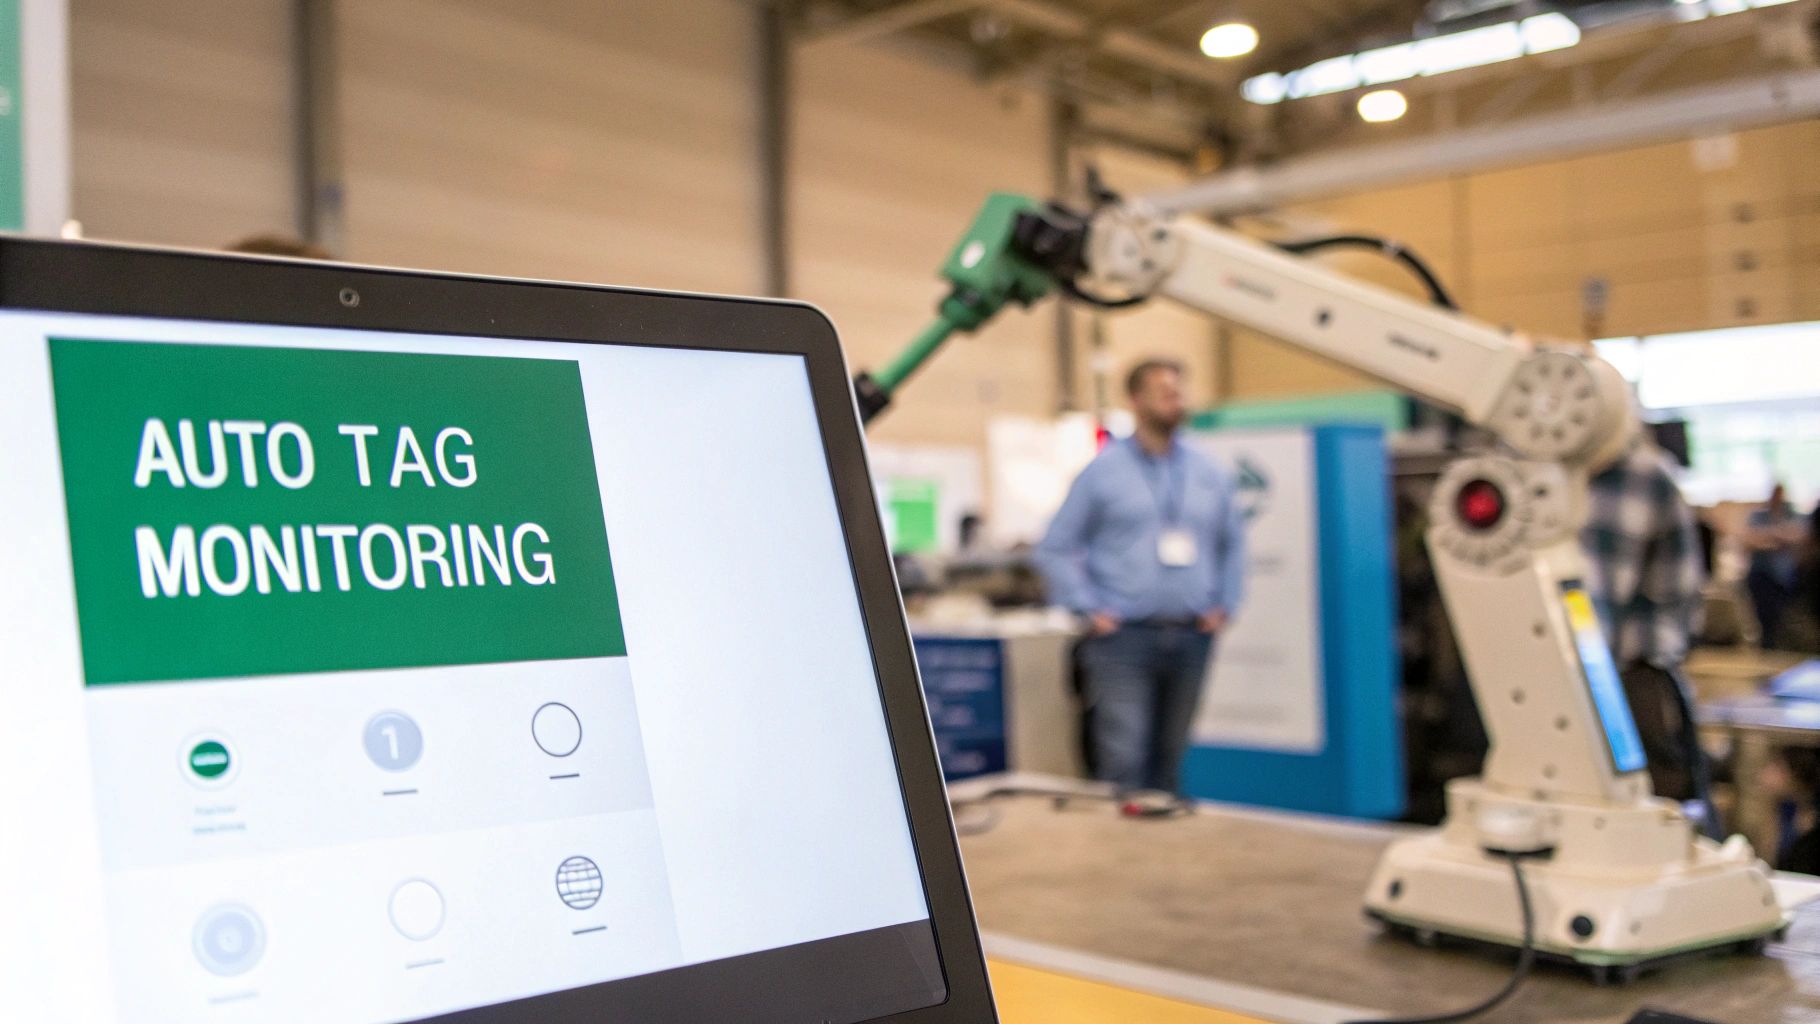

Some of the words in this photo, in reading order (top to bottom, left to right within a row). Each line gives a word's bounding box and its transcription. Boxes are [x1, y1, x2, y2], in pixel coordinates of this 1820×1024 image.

[135, 418, 315, 489] AUTO
[338, 424, 478, 488] TAG
[135, 522, 556, 598] MONITORING
[381, 726, 399, 760] 1
